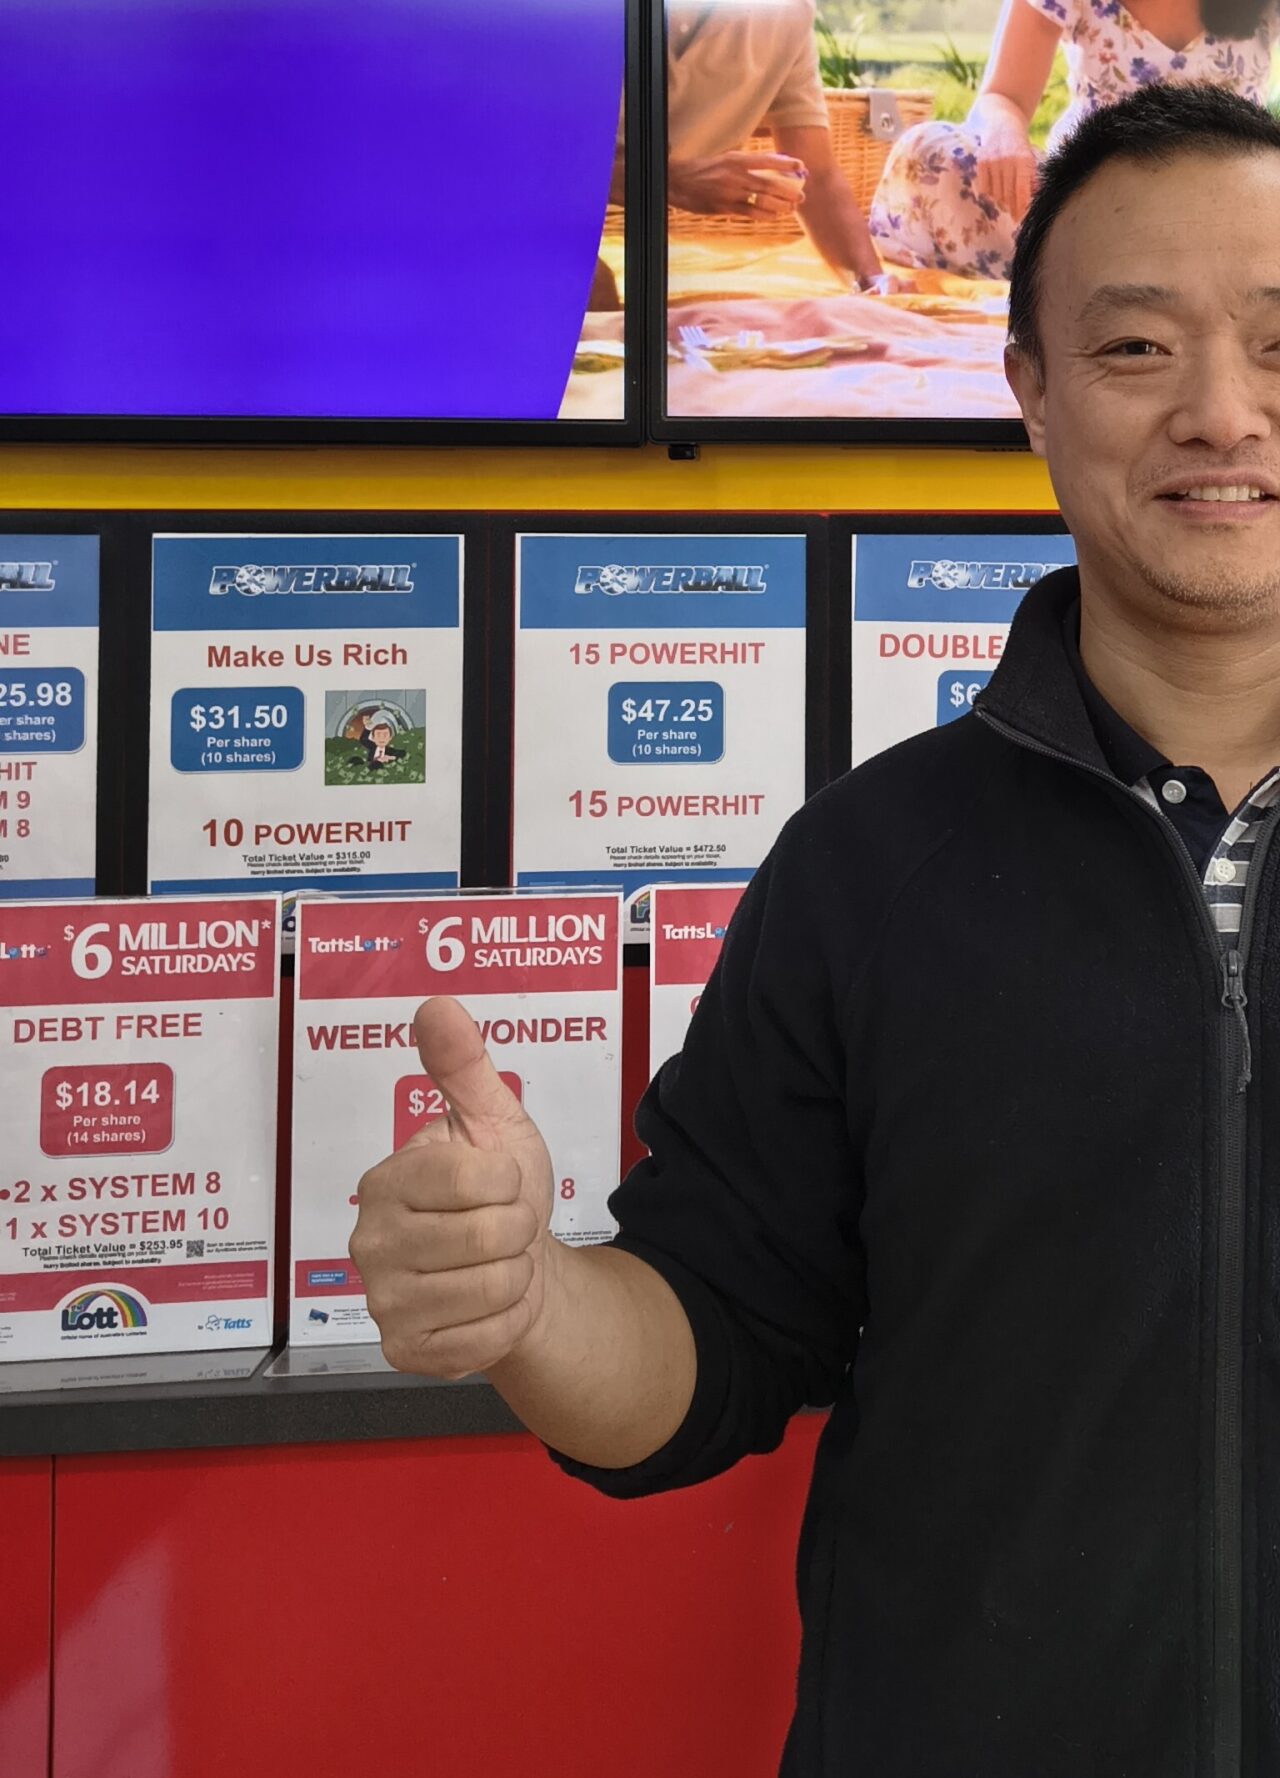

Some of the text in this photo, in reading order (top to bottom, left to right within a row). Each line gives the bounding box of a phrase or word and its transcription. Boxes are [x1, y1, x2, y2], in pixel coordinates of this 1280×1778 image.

[208, 563, 414, 596] POWERBALL
[574, 564, 767, 595] POWERBALL
[907, 559, 1066, 591] POWERB
[207, 643, 408, 668] Make Us Rich
[569, 642, 766, 665] 15 POWERHIT
[879, 634, 1004, 660] DOUBLE
[16, 715, 55, 726] share
[190, 704, 288, 731] $31.50
[621, 698, 713, 724] $47.25
[5, 731, 56, 743] shares)
[206, 736, 271, 748] Per share
[637, 729, 697, 741] Per share
[201, 751, 276, 766] (10 shares)
[632, 744, 702, 757] (10 shares)
[17, 791, 31, 809] 9
[569, 790, 765, 818] 15 POWERHIT
[17, 819, 30, 838] 8
[202, 818, 412, 847] 10 POWERHIT
[242, 854, 266, 862] Total
[269, 853, 296, 862] Ticket
[299, 852, 324, 860] Value
[606, 846, 627, 854] Total
[630, 845, 656, 854] Ticket
[659, 845, 683, 853] Value
[471, 914, 606, 944] MILLION
[64, 923, 113, 980] $6
[418, 916, 466, 972] $6
[121, 952, 256, 976] SATURDAYS
[474, 945, 603, 968] SATURDAYS
[13, 1013, 203, 1044] DEBT FREE
[306, 1022, 418, 1051] WEEKL
[55, 1080, 160, 1111] $18.14
[73, 1113, 141, 1127] Per share
[67, 1129, 146, 1146] (14 shares)
[14, 1171, 222, 1203] 2 x SYSTEM 8
[560, 1178, 575, 1199] 8
[5, 1207, 230, 1240] 1 x SYSTEM 10
[23, 1239, 183, 1257] Total Ticket Value $253.95
[61, 1307, 119, 1332] Lott
[223, 1318, 252, 1329] Tatts
